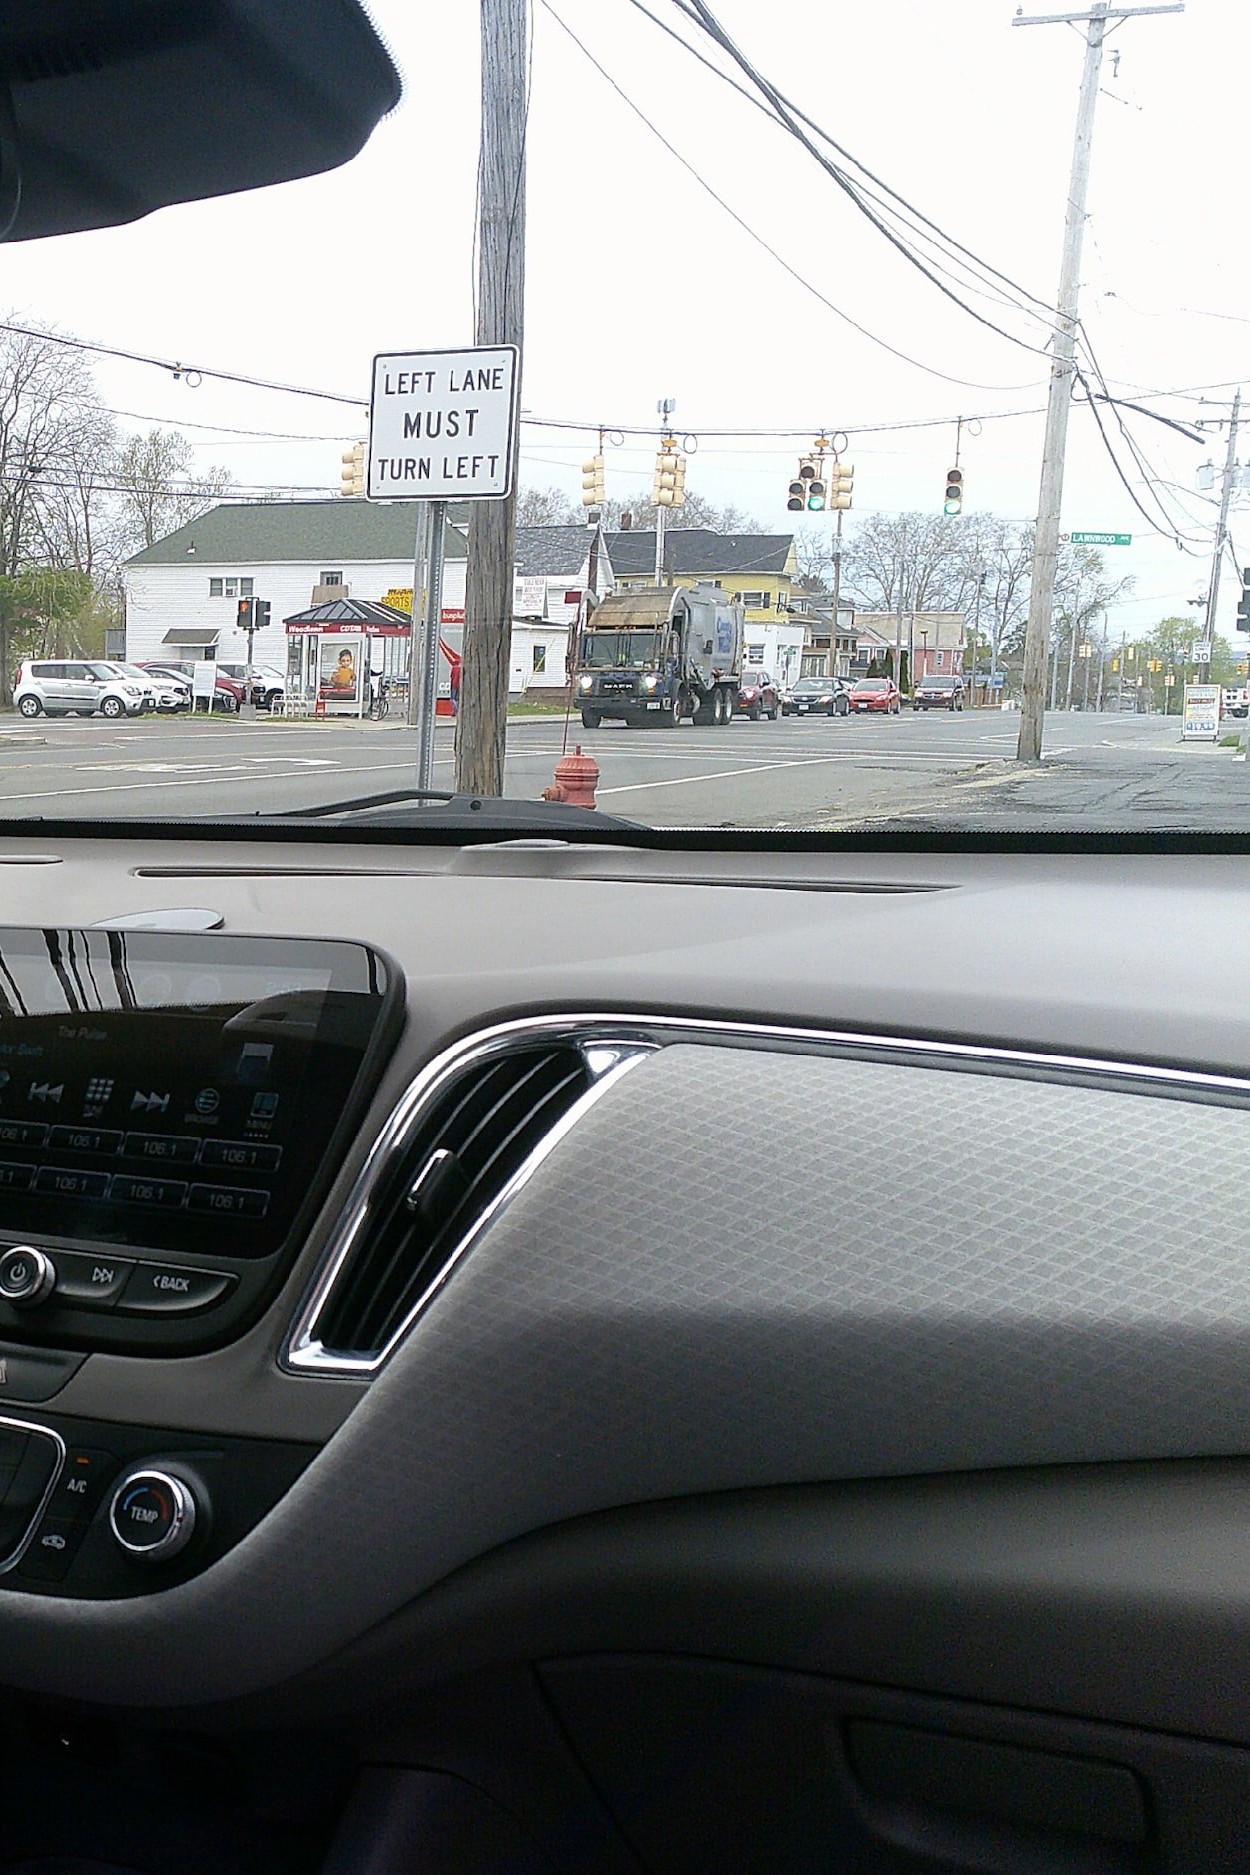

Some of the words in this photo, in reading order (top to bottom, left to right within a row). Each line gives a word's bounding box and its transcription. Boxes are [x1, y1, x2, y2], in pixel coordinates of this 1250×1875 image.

[385, 371, 436, 395] LEFT
[449, 368, 504, 392] LANE
[403, 409, 479, 439] MUST
[378, 457, 431, 481] TURN
[443, 455, 499, 479] LEFT
[381, 596, 410, 608] SPORTS
[1194, 652, 1209, 662] 30
[160, 1275, 190, 1292] BACK
[67, 1478, 87, 1494] A/C
[131, 1505, 159, 1523] TEMP
